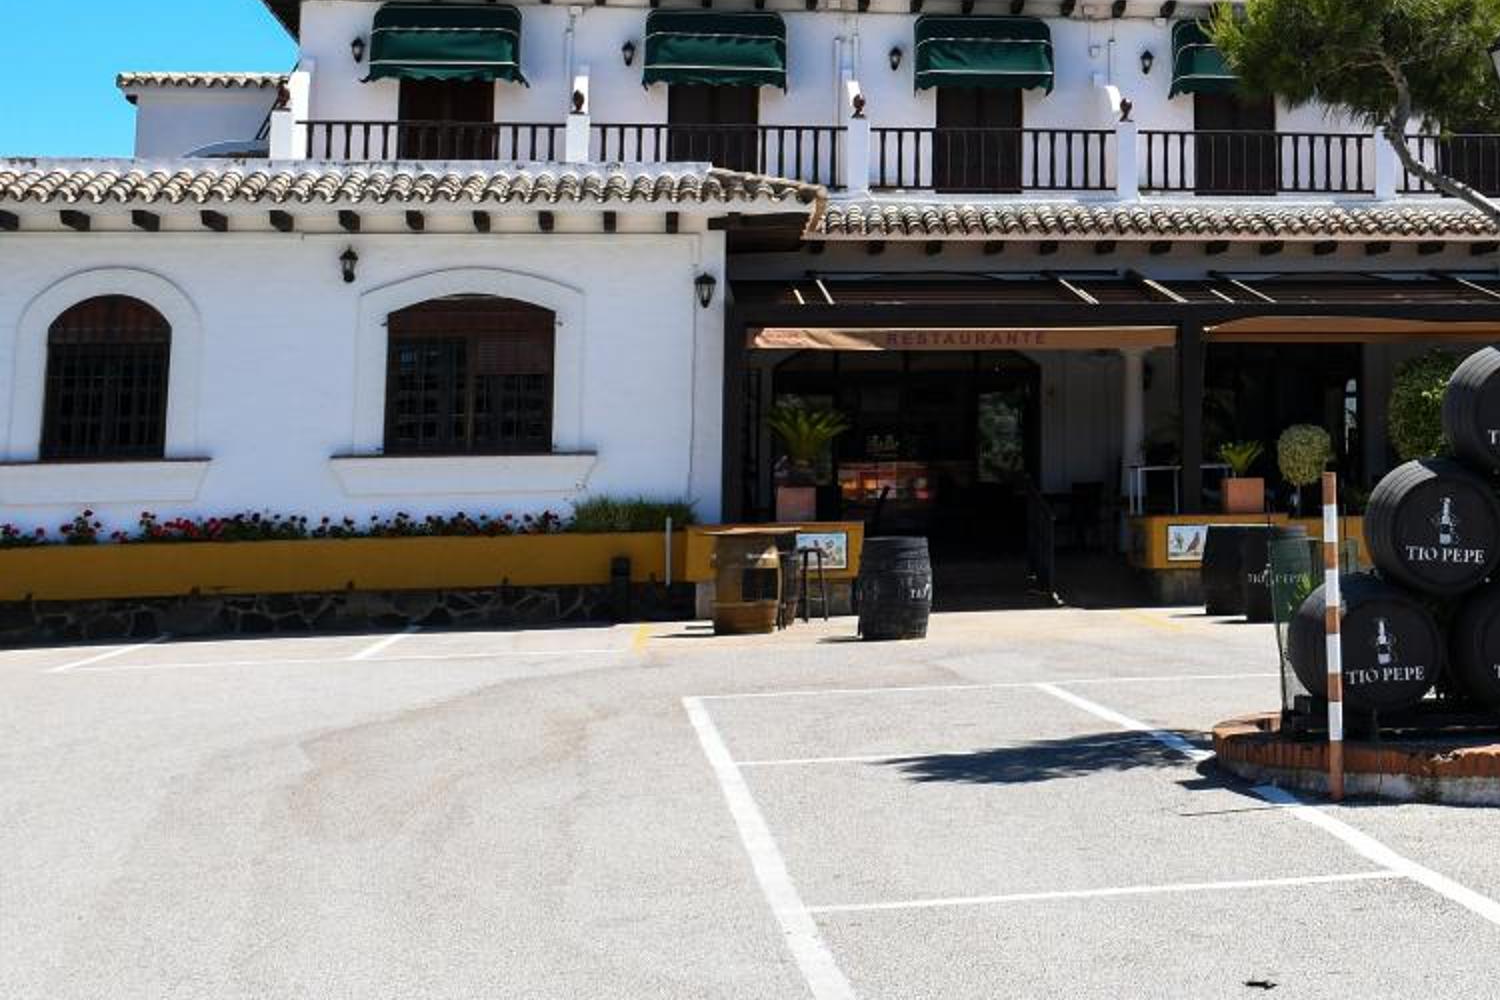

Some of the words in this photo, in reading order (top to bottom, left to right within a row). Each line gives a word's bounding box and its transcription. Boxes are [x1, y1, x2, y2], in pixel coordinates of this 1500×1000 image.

[886, 331, 1046, 345] RESTAURANTE
[1406, 545, 1437, 561] TIO
[1442, 549, 1485, 563] PEPE
[1346, 669, 1379, 685] TIO
[1383, 665, 1425, 682] PEPE
